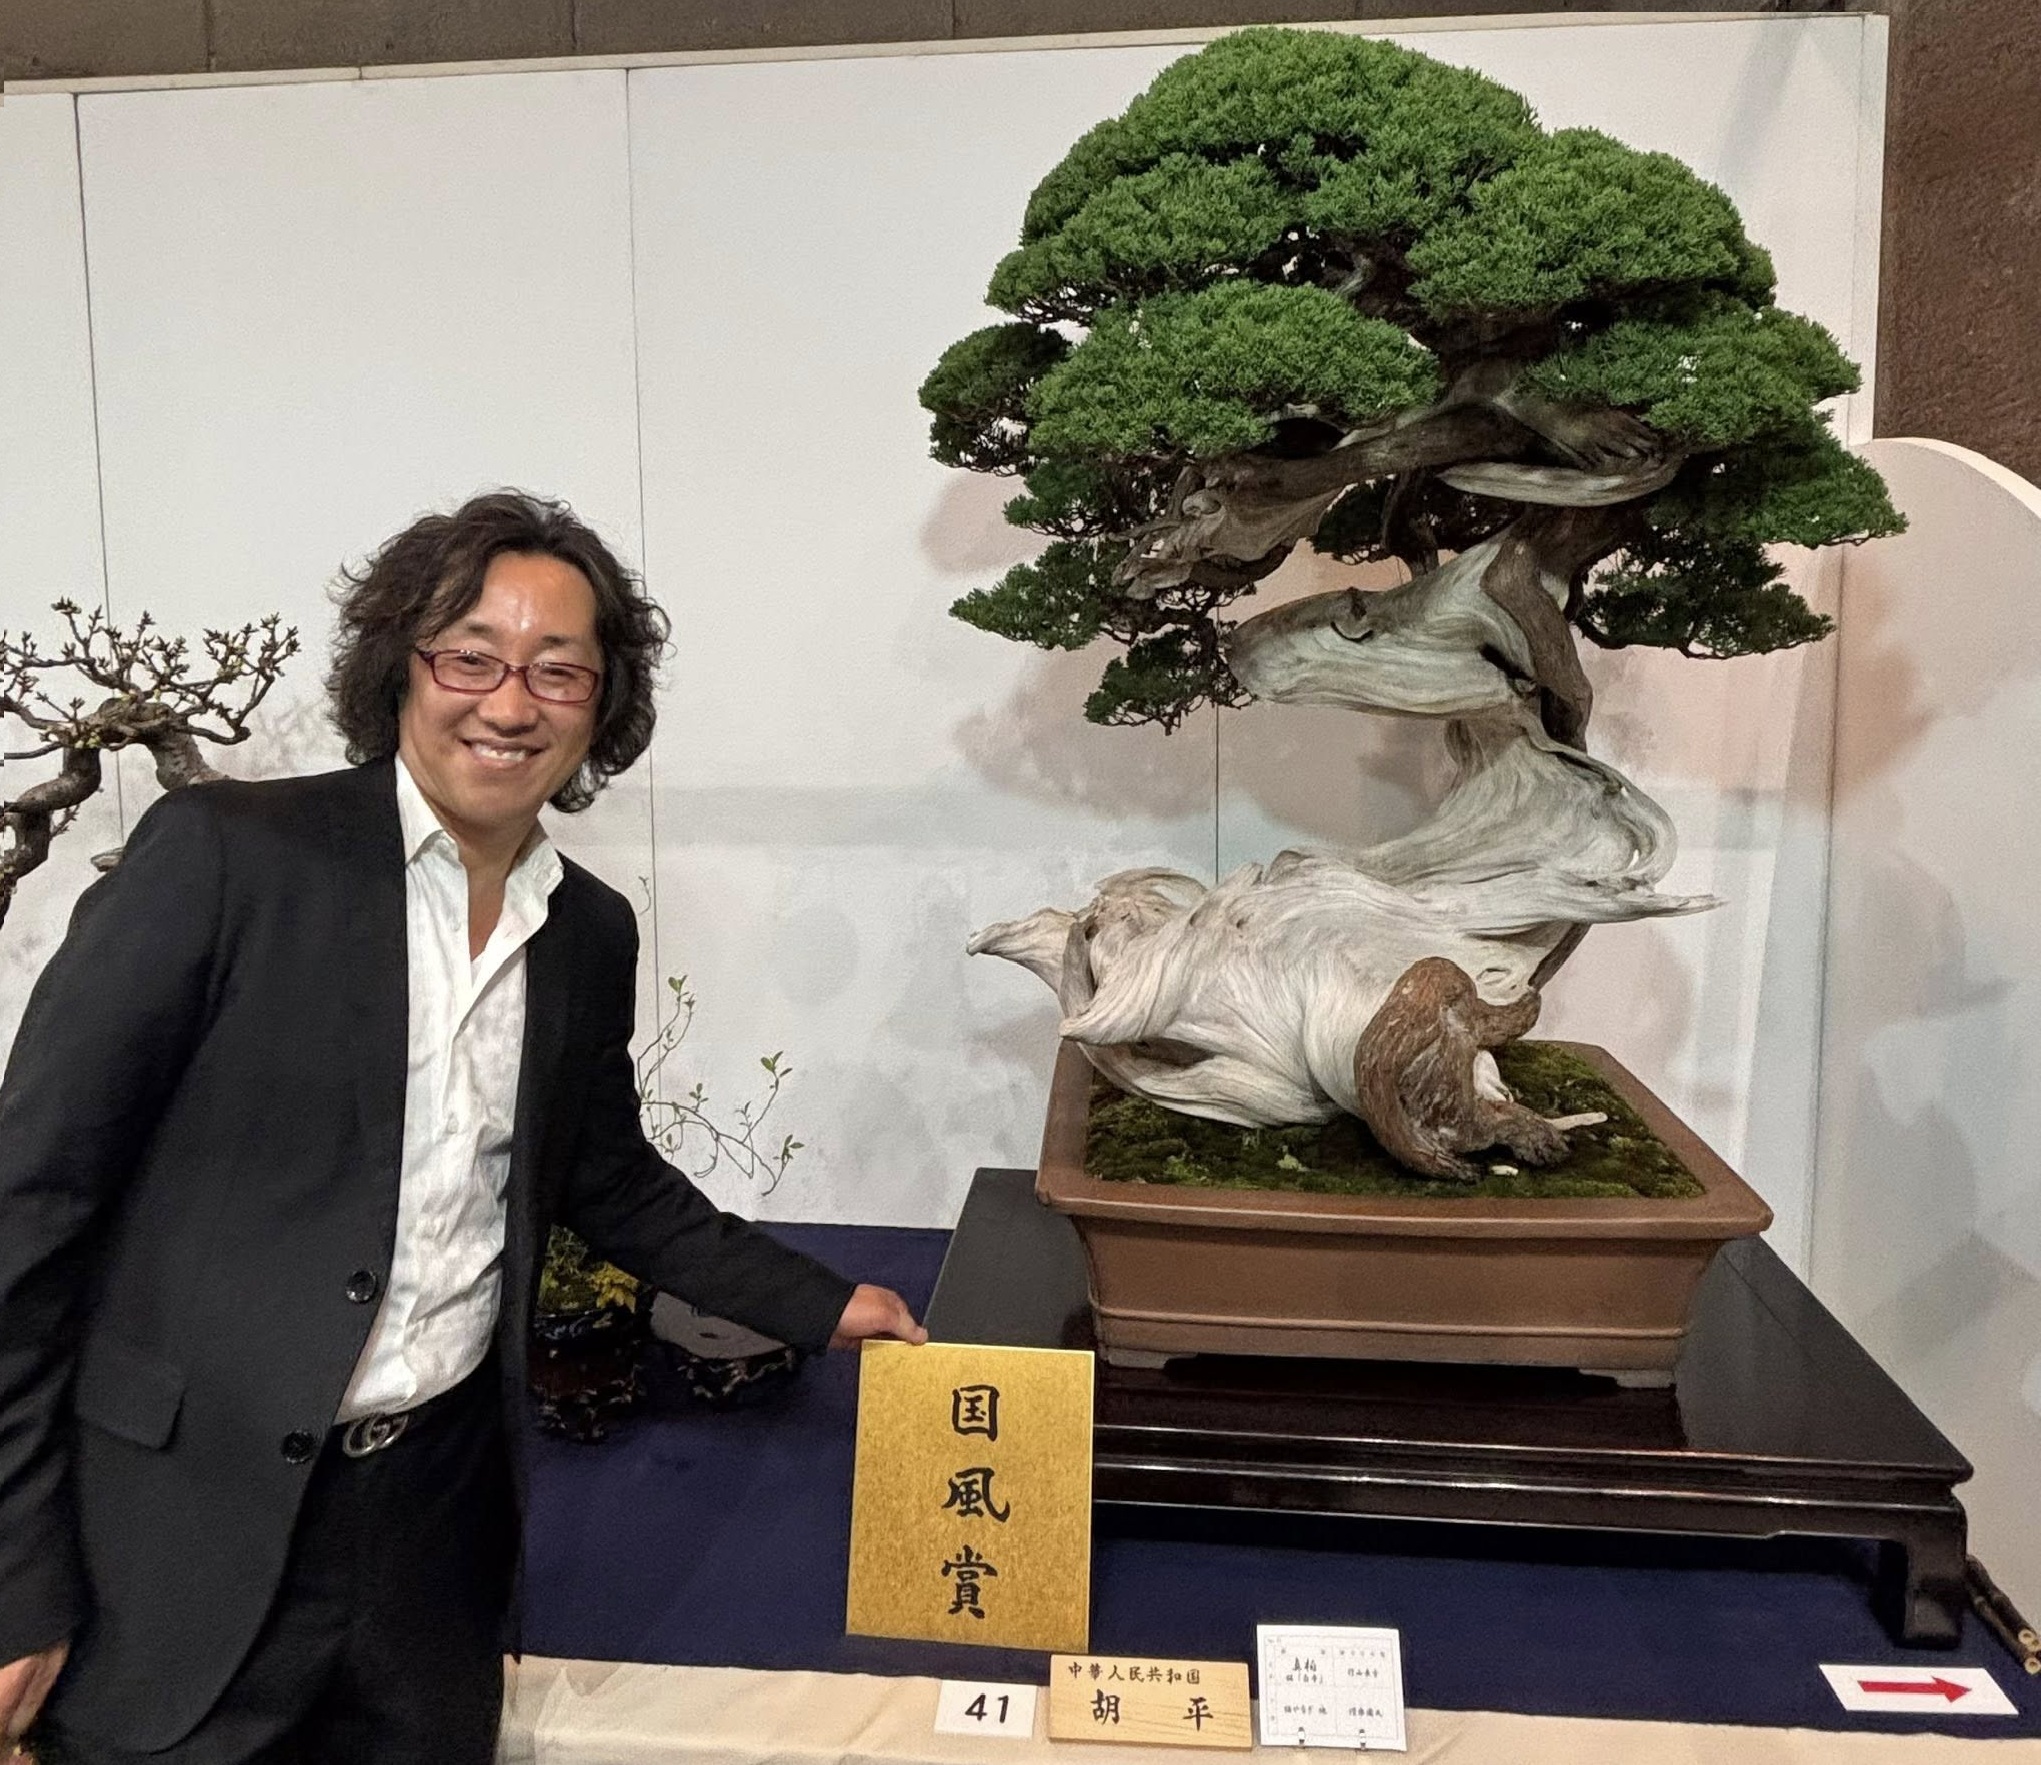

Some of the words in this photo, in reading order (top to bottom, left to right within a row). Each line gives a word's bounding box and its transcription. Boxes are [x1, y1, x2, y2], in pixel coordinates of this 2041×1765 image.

[941, 1384, 1010, 1619] 国風賞
[1068, 1661, 1201, 1685] 中華人民共和国
[965, 1693, 1009, 1724] 41
